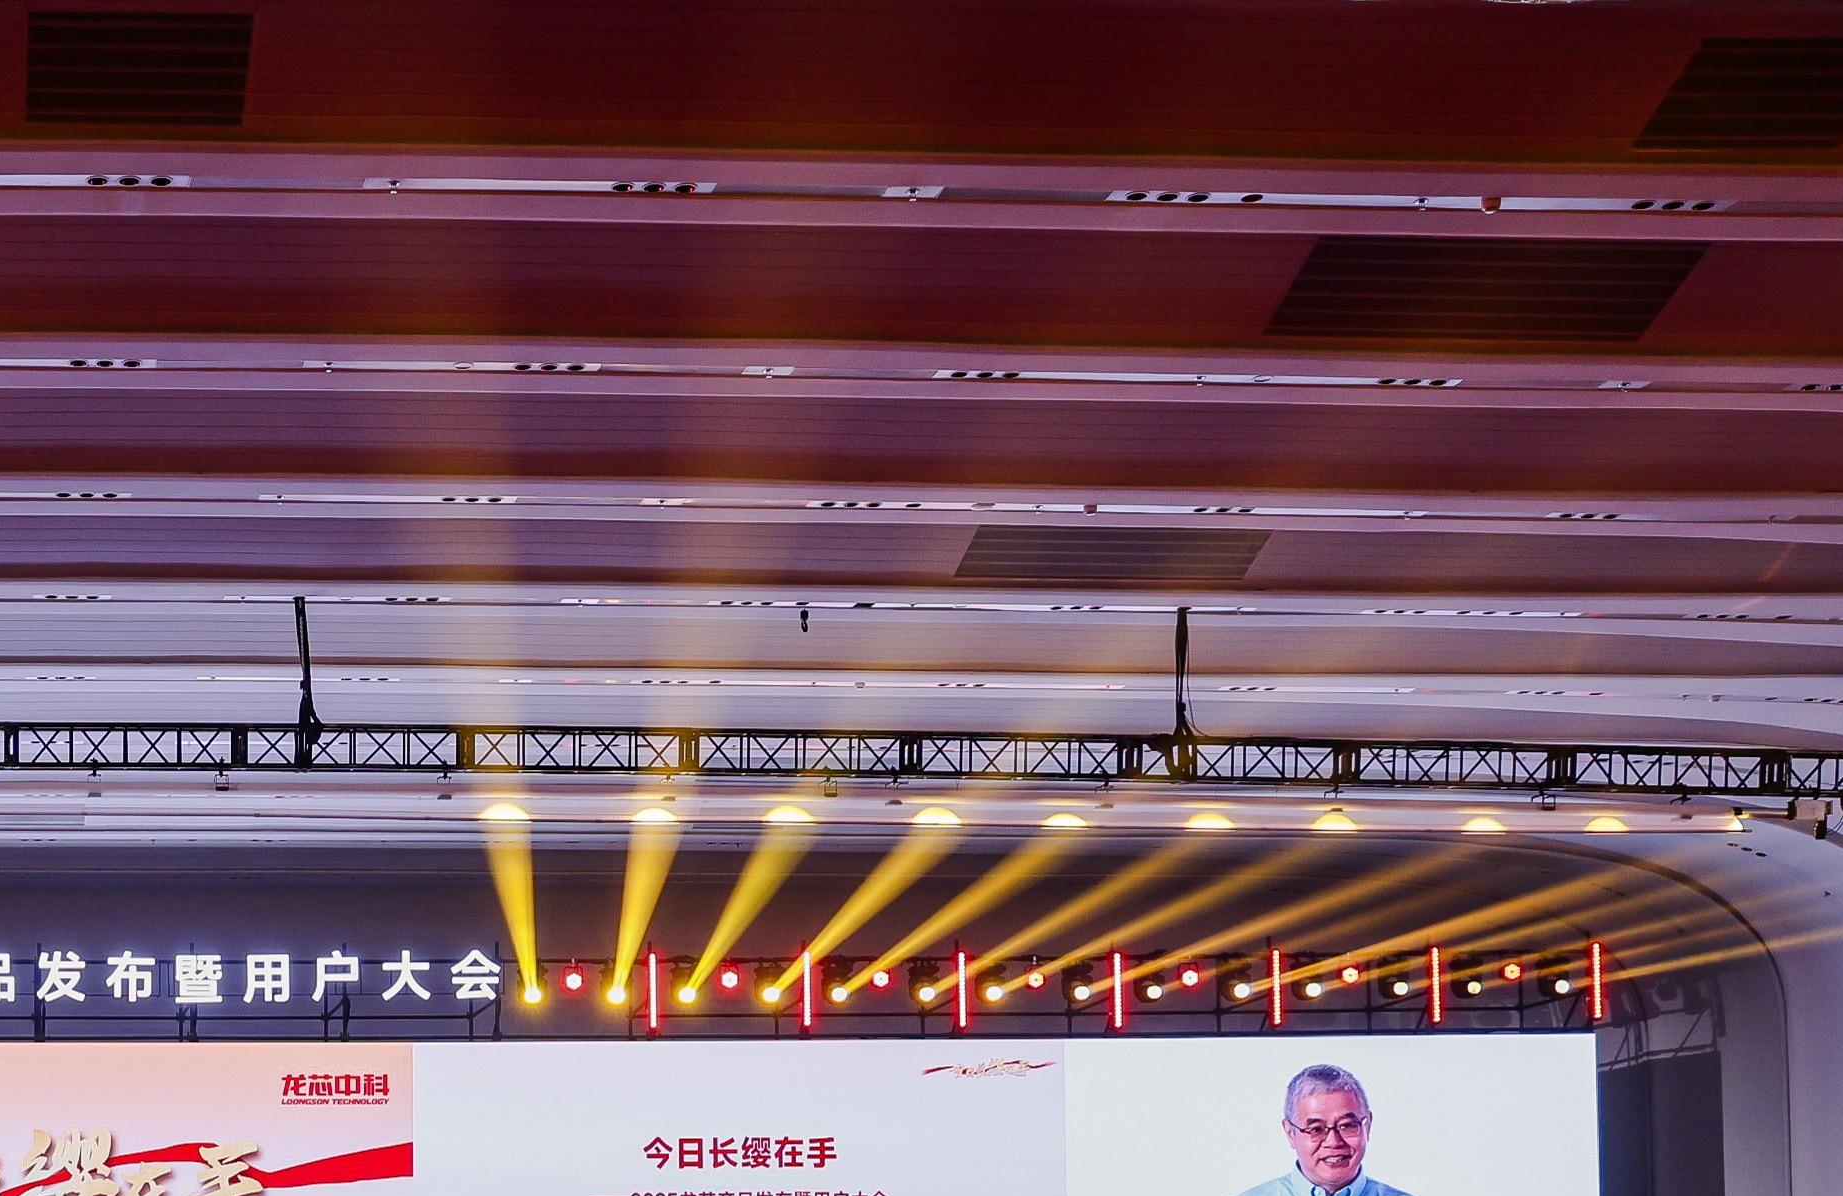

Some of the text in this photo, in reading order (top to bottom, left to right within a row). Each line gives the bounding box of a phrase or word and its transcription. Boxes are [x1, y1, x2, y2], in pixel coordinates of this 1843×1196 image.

[281, 1073, 390, 1096] 龙芯中科
[643, 1136, 838, 1170] 今日长缨在手
